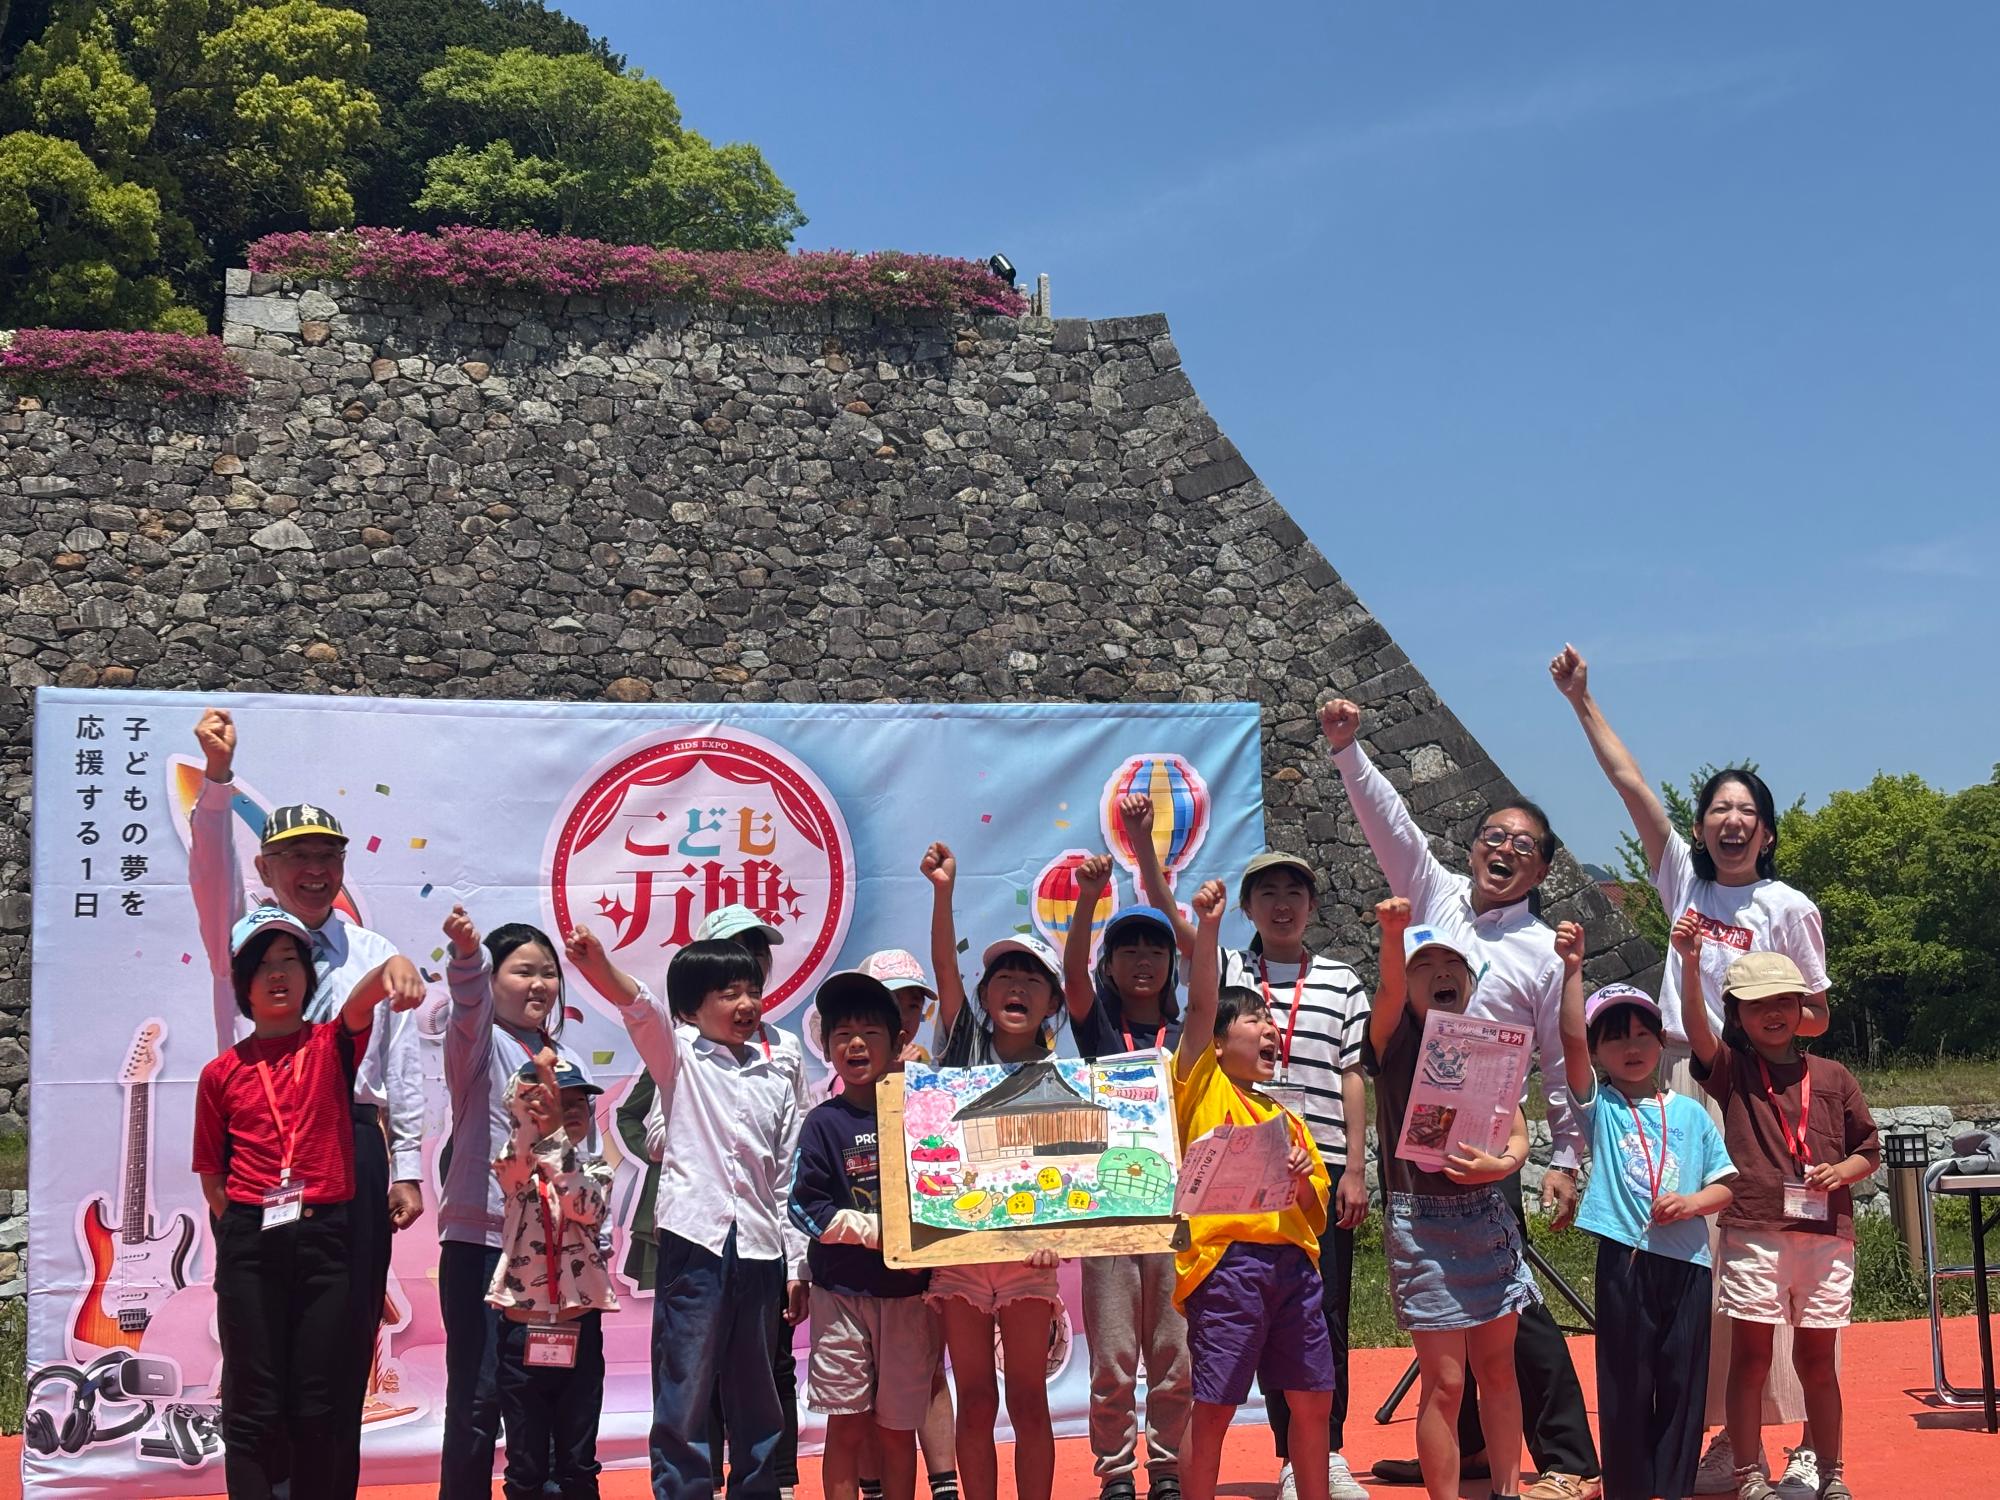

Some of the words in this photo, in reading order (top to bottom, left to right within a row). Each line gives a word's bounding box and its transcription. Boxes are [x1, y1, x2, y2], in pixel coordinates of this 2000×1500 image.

[673, 740, 699, 751] KIDS
[701, 740, 729, 751] EXPO
[74, 714, 105, 919] 応援する1日
[119, 716, 152, 918] 子どもの夢を
[623, 806, 777, 857] こども
[1500, 1030, 1523, 1045] 号外
